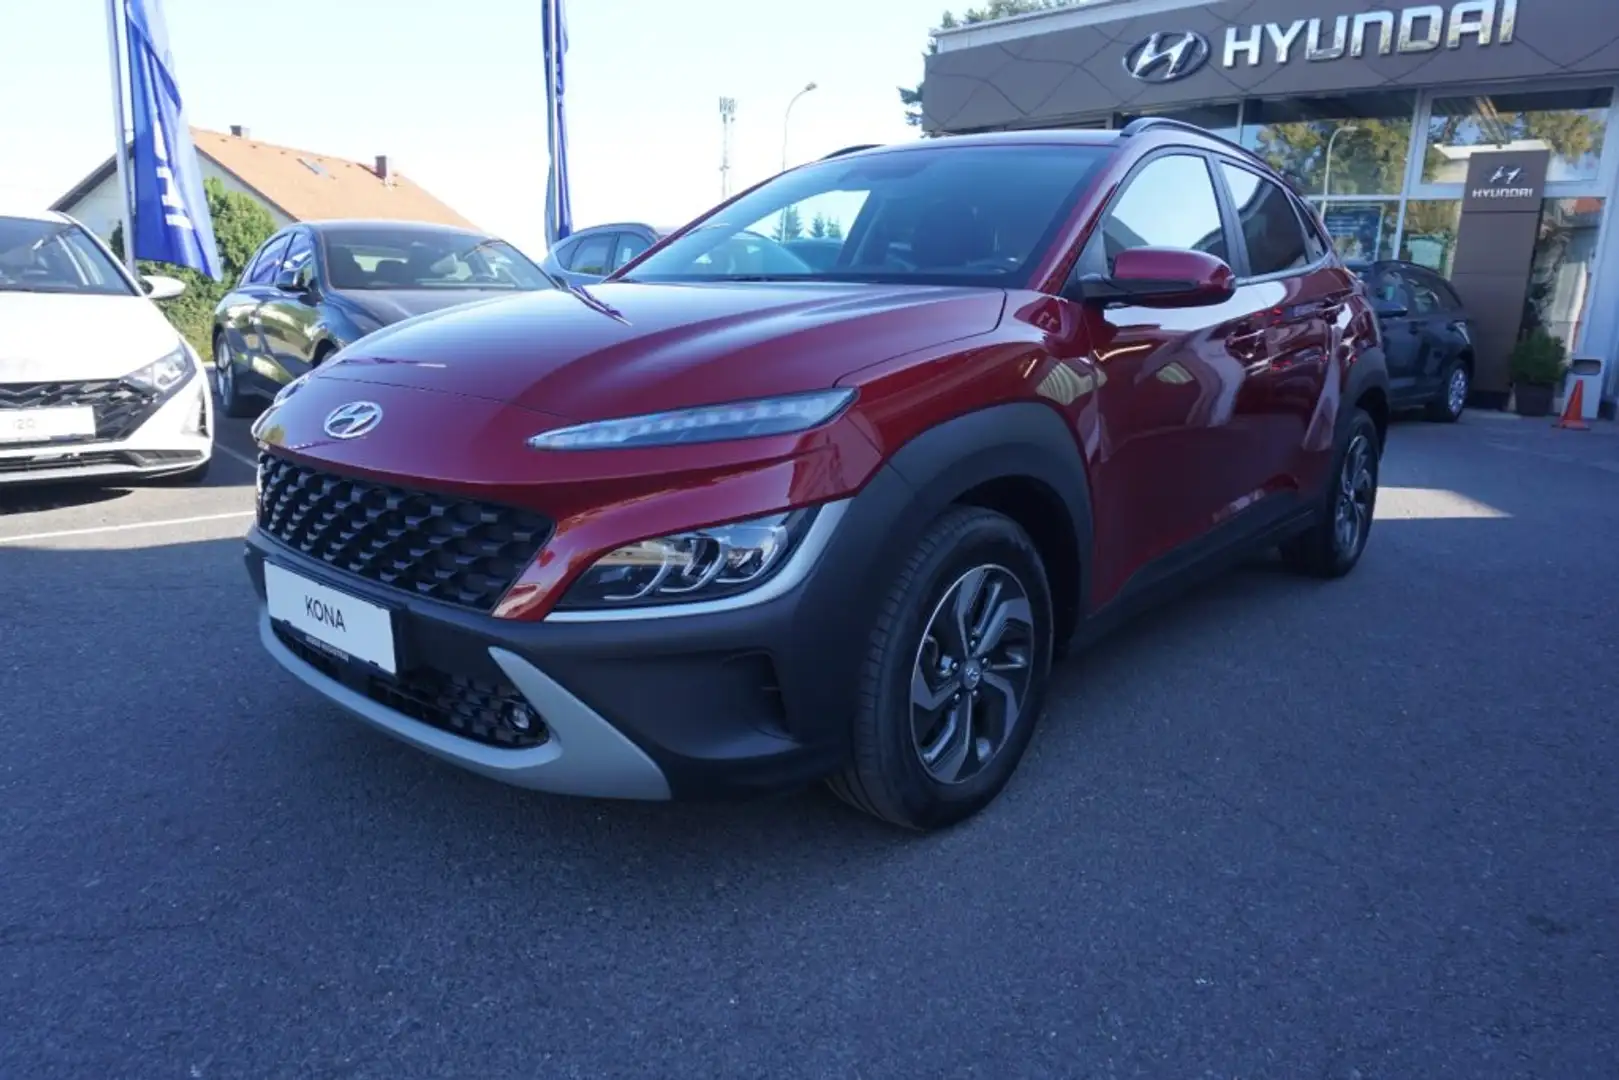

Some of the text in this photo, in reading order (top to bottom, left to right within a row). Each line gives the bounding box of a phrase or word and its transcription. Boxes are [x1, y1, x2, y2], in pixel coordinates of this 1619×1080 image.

[1223, 0, 1517, 67] HYUNDAI
[1472, 187, 1533, 198] HYUNDAI
[305, 595, 346, 632] KONA
